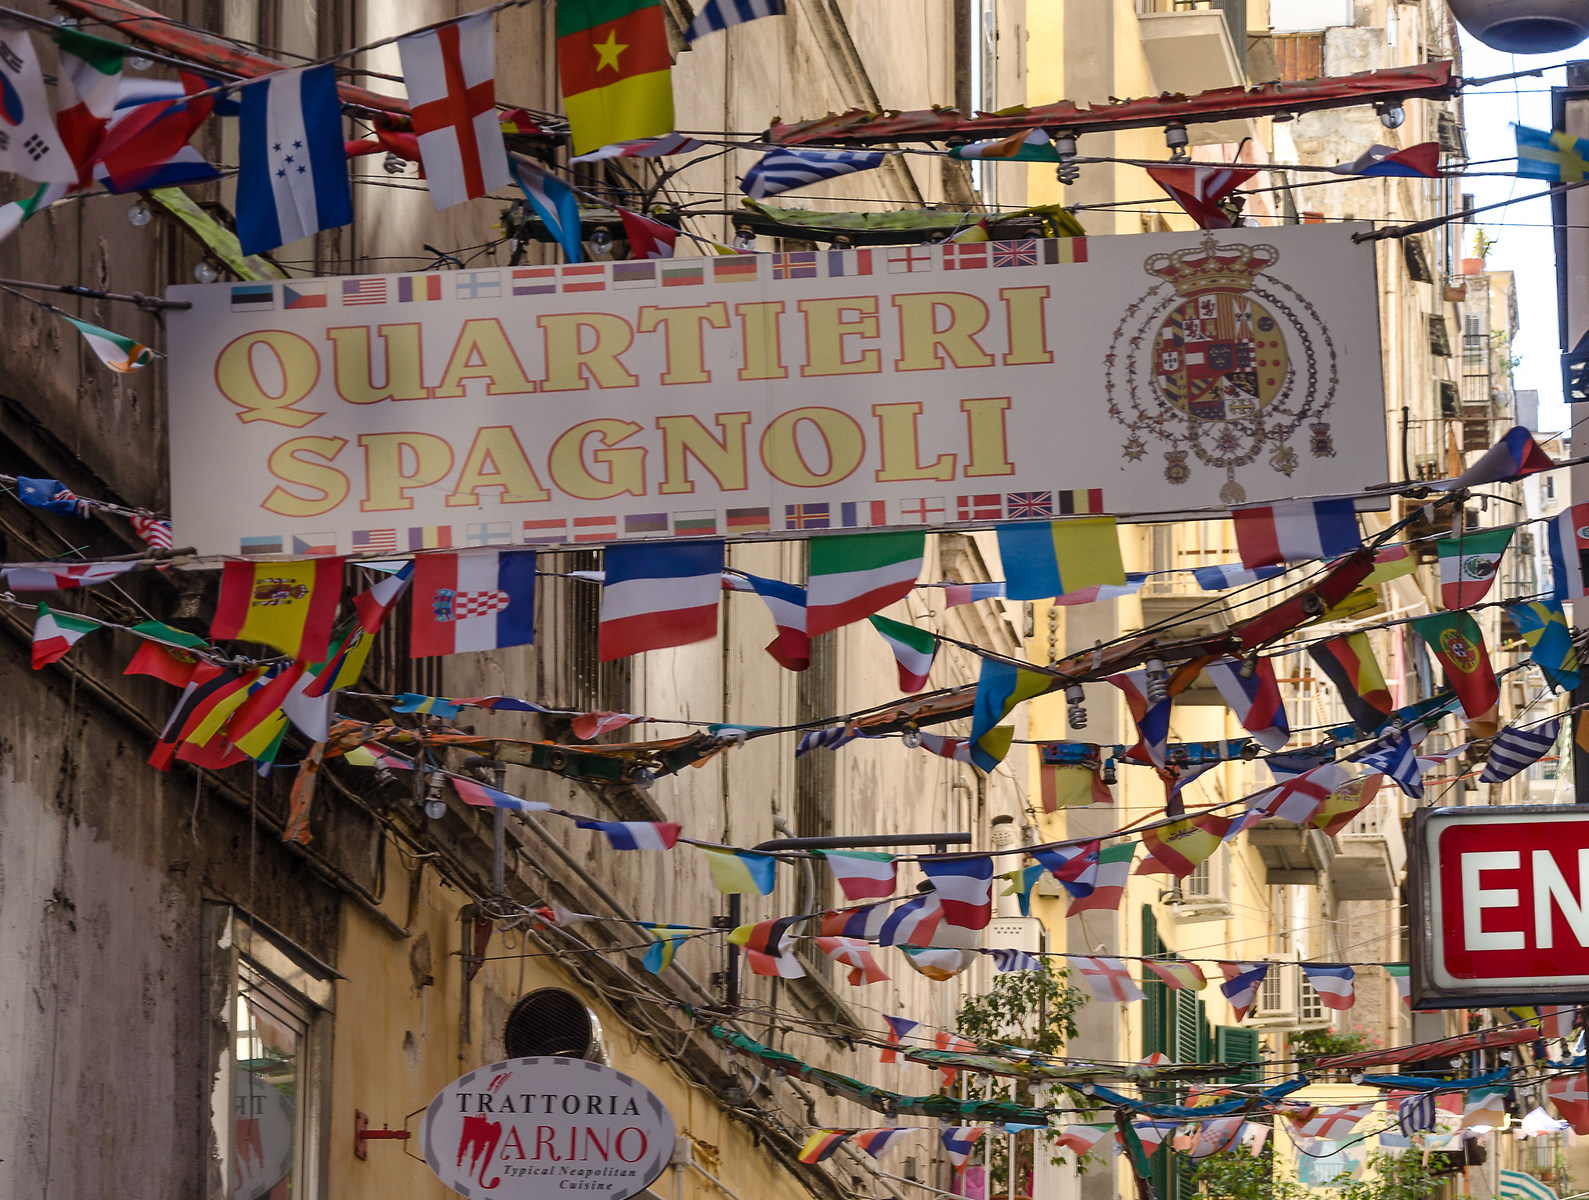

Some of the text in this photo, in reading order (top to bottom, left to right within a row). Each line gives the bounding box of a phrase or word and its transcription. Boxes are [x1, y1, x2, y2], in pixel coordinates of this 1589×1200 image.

[214, 284, 1055, 427] QUARTIERI
[260, 395, 1015, 518] SPAGNOLI
[1461, 849, 1589, 952] EN
[456, 1092, 641, 1117] TRATTORIA
[456, 1115, 648, 1190] MARINO
[504, 1165, 637, 1180] Typical Neapolitan
[559, 1179, 614, 1191] Cuisine
